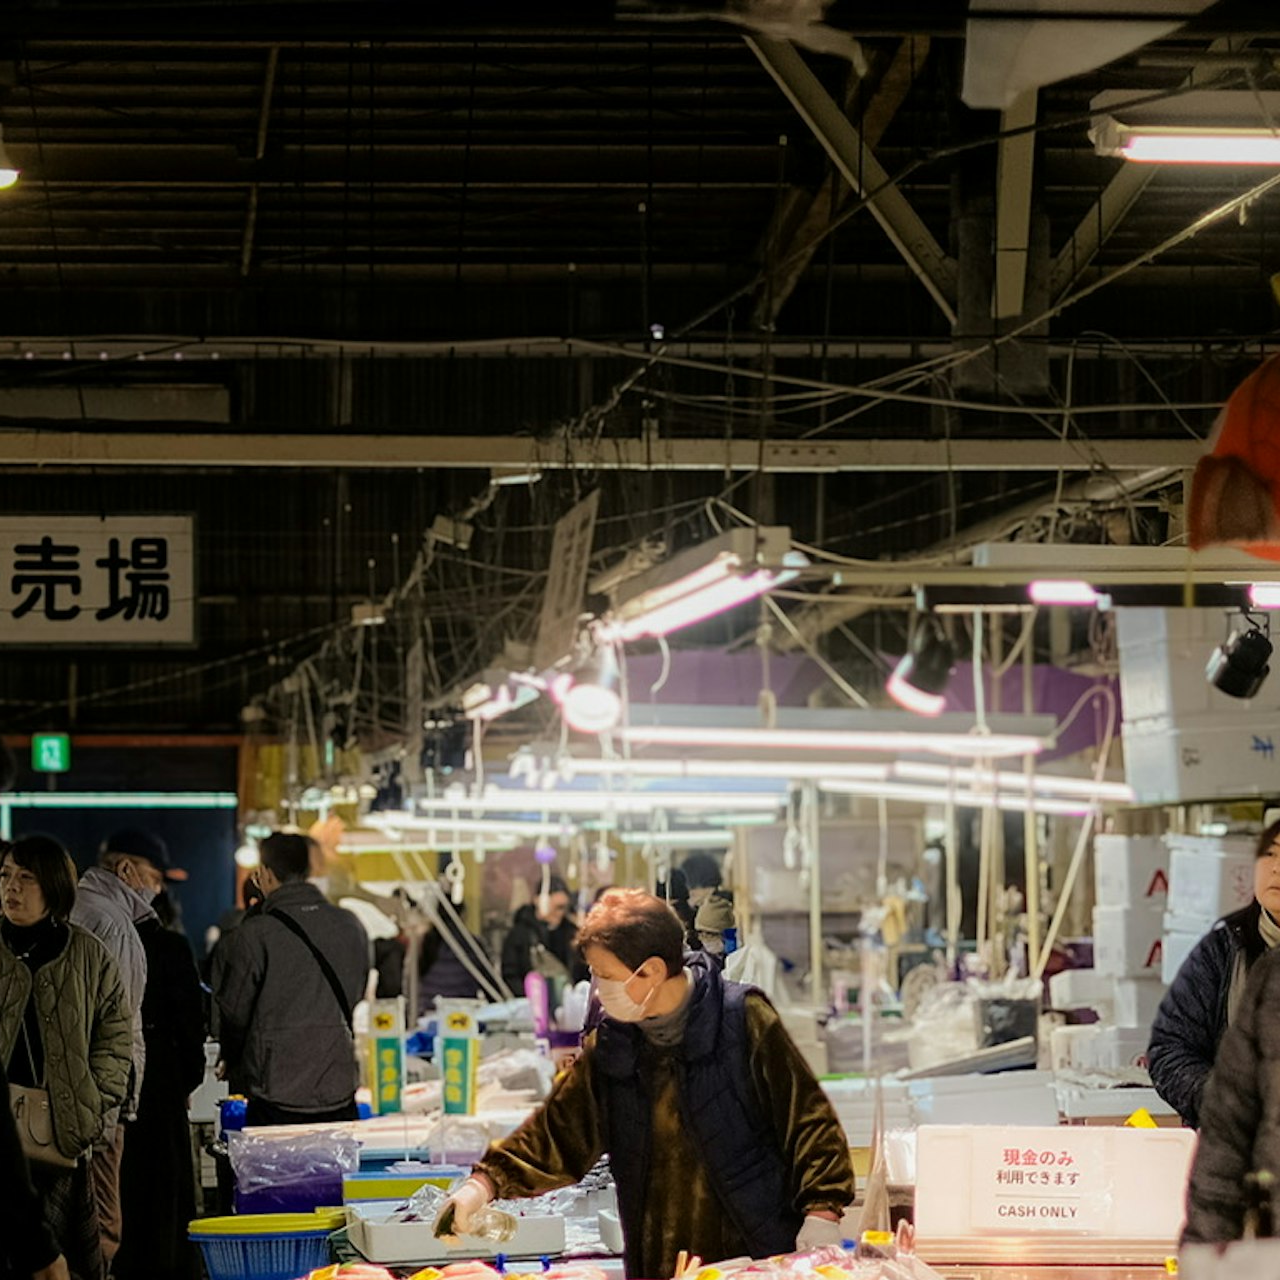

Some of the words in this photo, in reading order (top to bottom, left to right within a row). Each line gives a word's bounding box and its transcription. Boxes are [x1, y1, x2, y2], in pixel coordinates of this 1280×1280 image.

[1002, 1147, 1074, 1167] 現金のみ
[995, 1169, 1081, 1186] 利用できます
[997, 1204, 1037, 1217] CASH
[1039, 1205, 1078, 1218] ONLY
